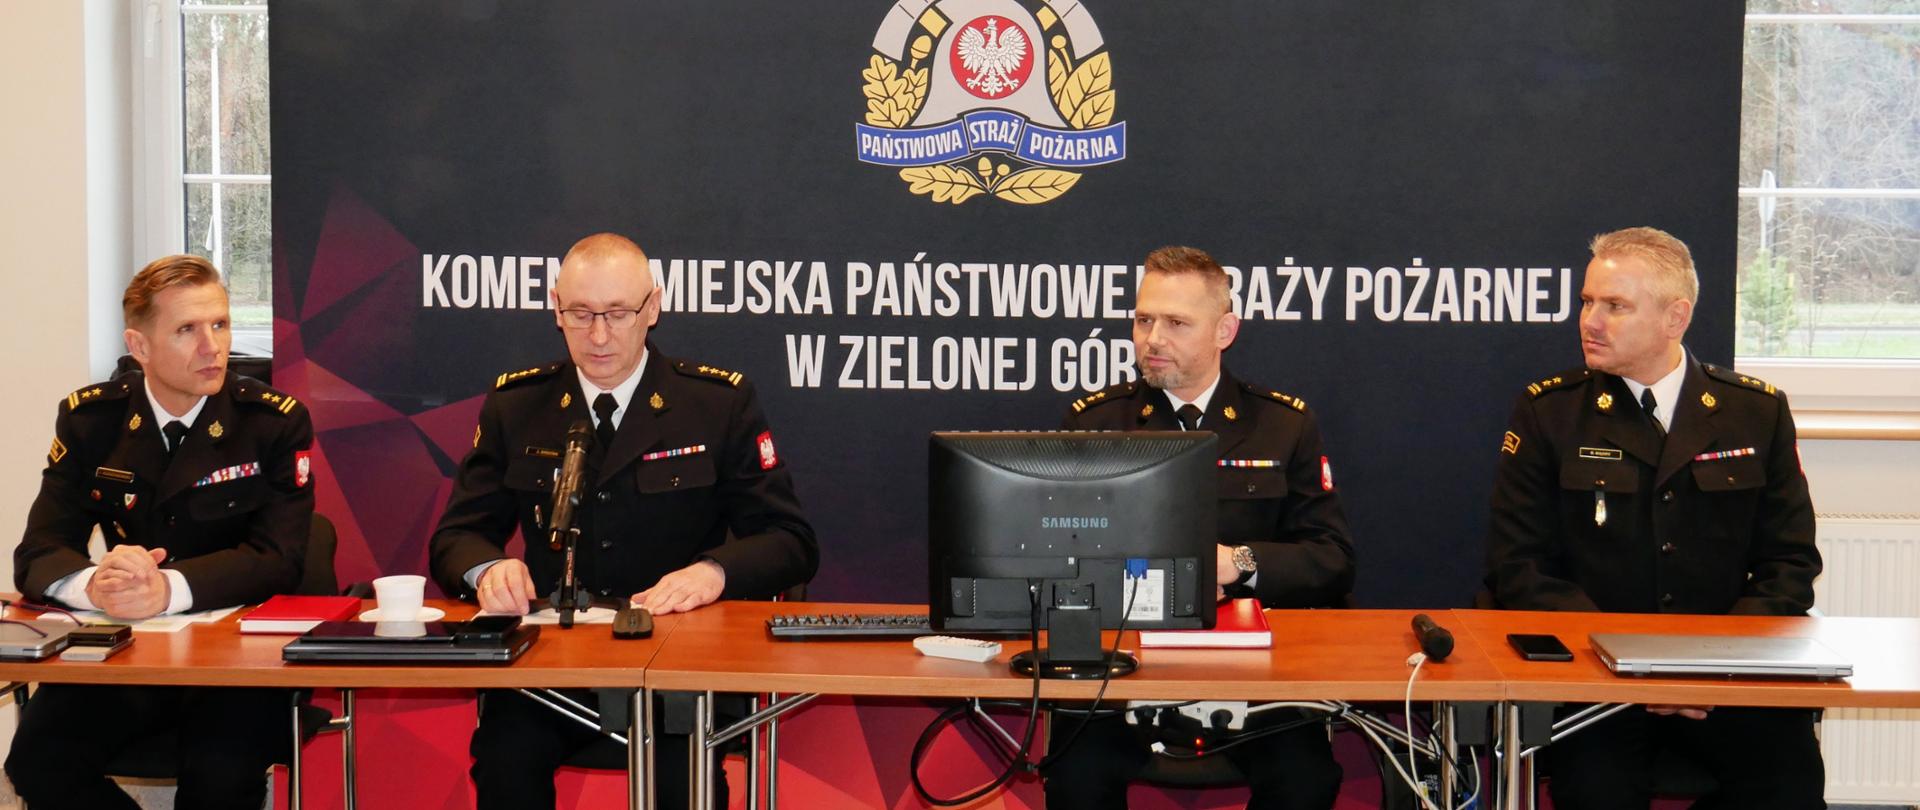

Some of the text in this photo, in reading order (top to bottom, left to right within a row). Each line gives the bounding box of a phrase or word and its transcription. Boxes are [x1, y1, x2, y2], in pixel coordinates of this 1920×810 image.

[861, 118, 1119, 161] PAŃSTWOWA STRAŻ POŻARNA
[422, 254, 560, 309] KOME
[649, 258, 832, 314] MIEJSKA
[1221, 257, 1332, 321] RAŻY
[1346, 257, 1571, 322] POŻARNEJ
[785, 327, 1137, 392] W ZIELONEJ GÓR
[1041, 516, 1109, 529] SAMSUNG
